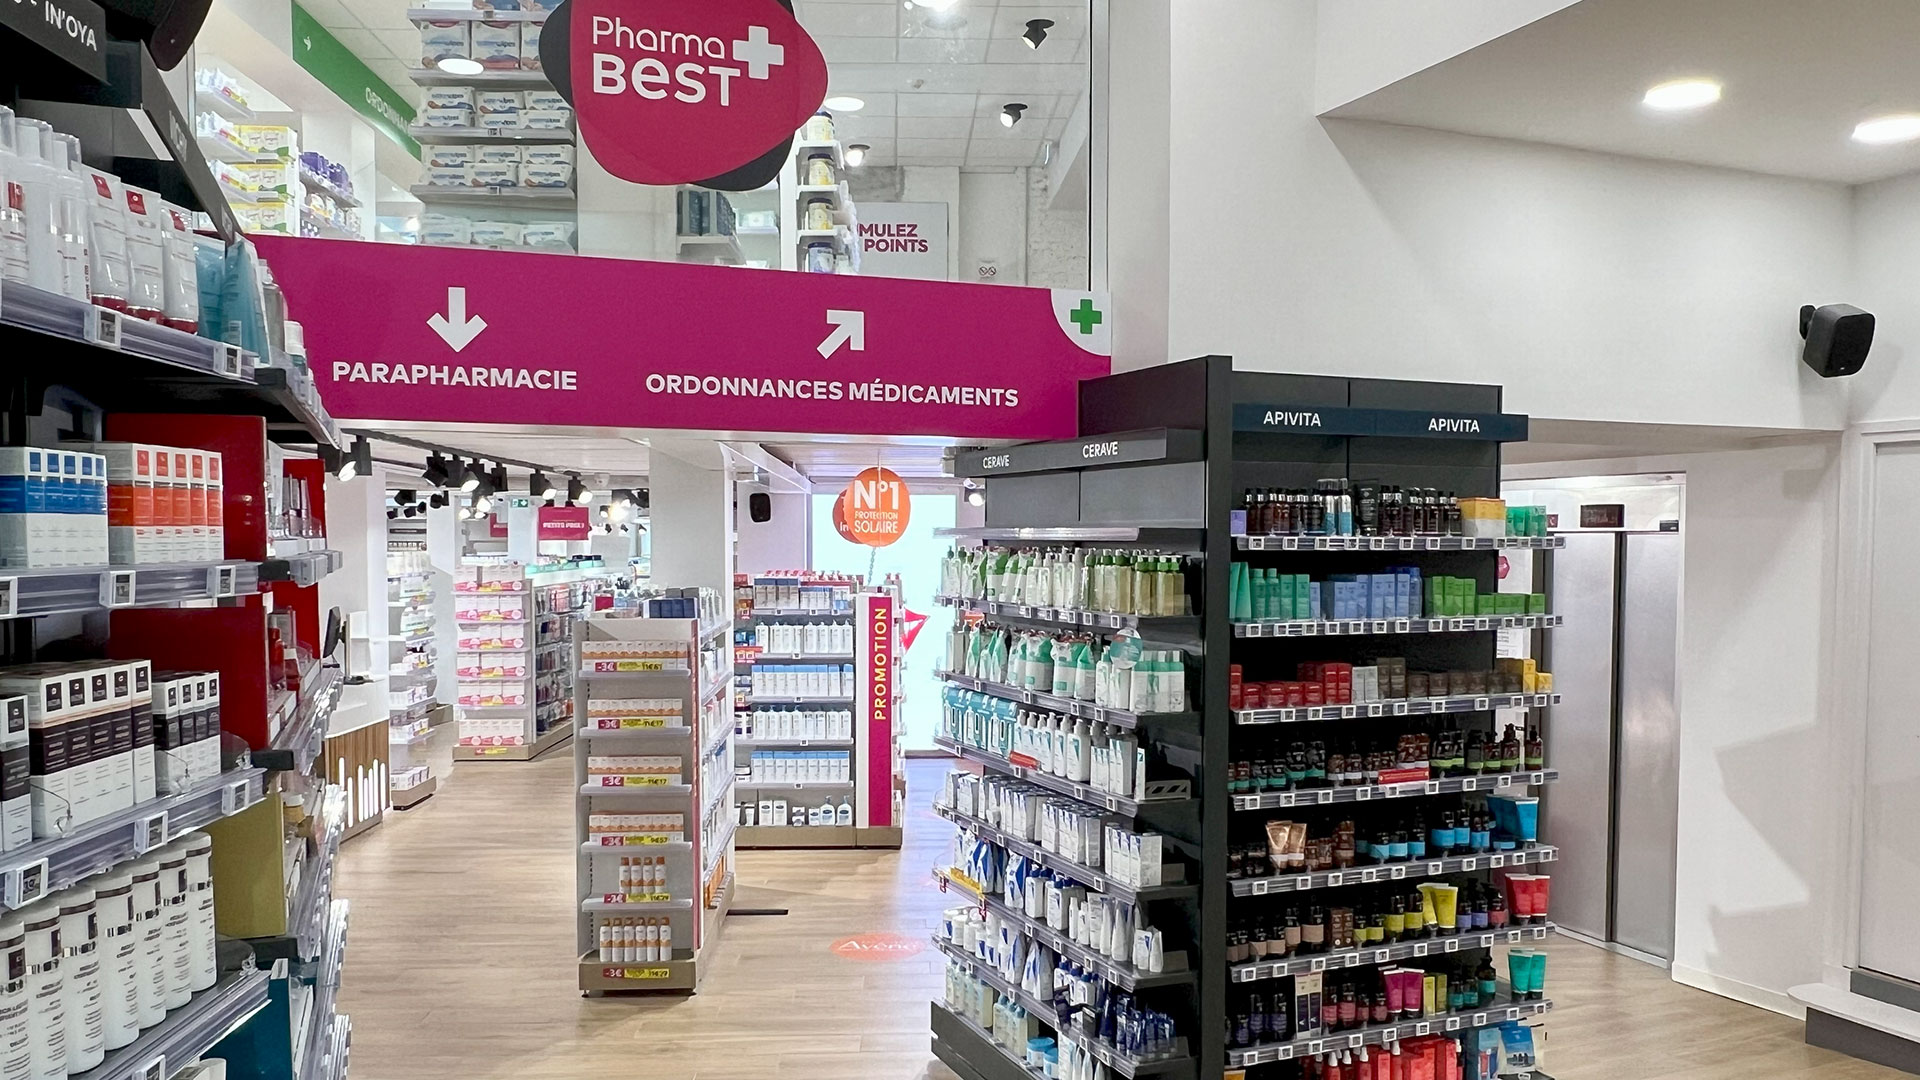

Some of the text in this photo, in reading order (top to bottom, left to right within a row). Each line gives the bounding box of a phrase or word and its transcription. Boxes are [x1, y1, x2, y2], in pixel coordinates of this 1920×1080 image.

[592, 15, 725, 60] Pharma
[857, 223, 918, 238] MULEZ
[864, 238, 929, 253] POINTS
[332, 361, 578, 391] PARAPHARMACIE
[645, 374, 1019, 408] ORDONNANCES MÉDICAMENTS
[1263, 410, 1322, 427] APIVITA
[1428, 418, 1480, 433] APIVITA
[1082, 441, 1119, 459] CERAVE
[982, 454, 1010, 469] CERAVE
[854, 511, 899, 520] PROTECTION
[854, 520, 899, 534] SOLAIRE
[874, 608, 887, 720] PROMOTION
